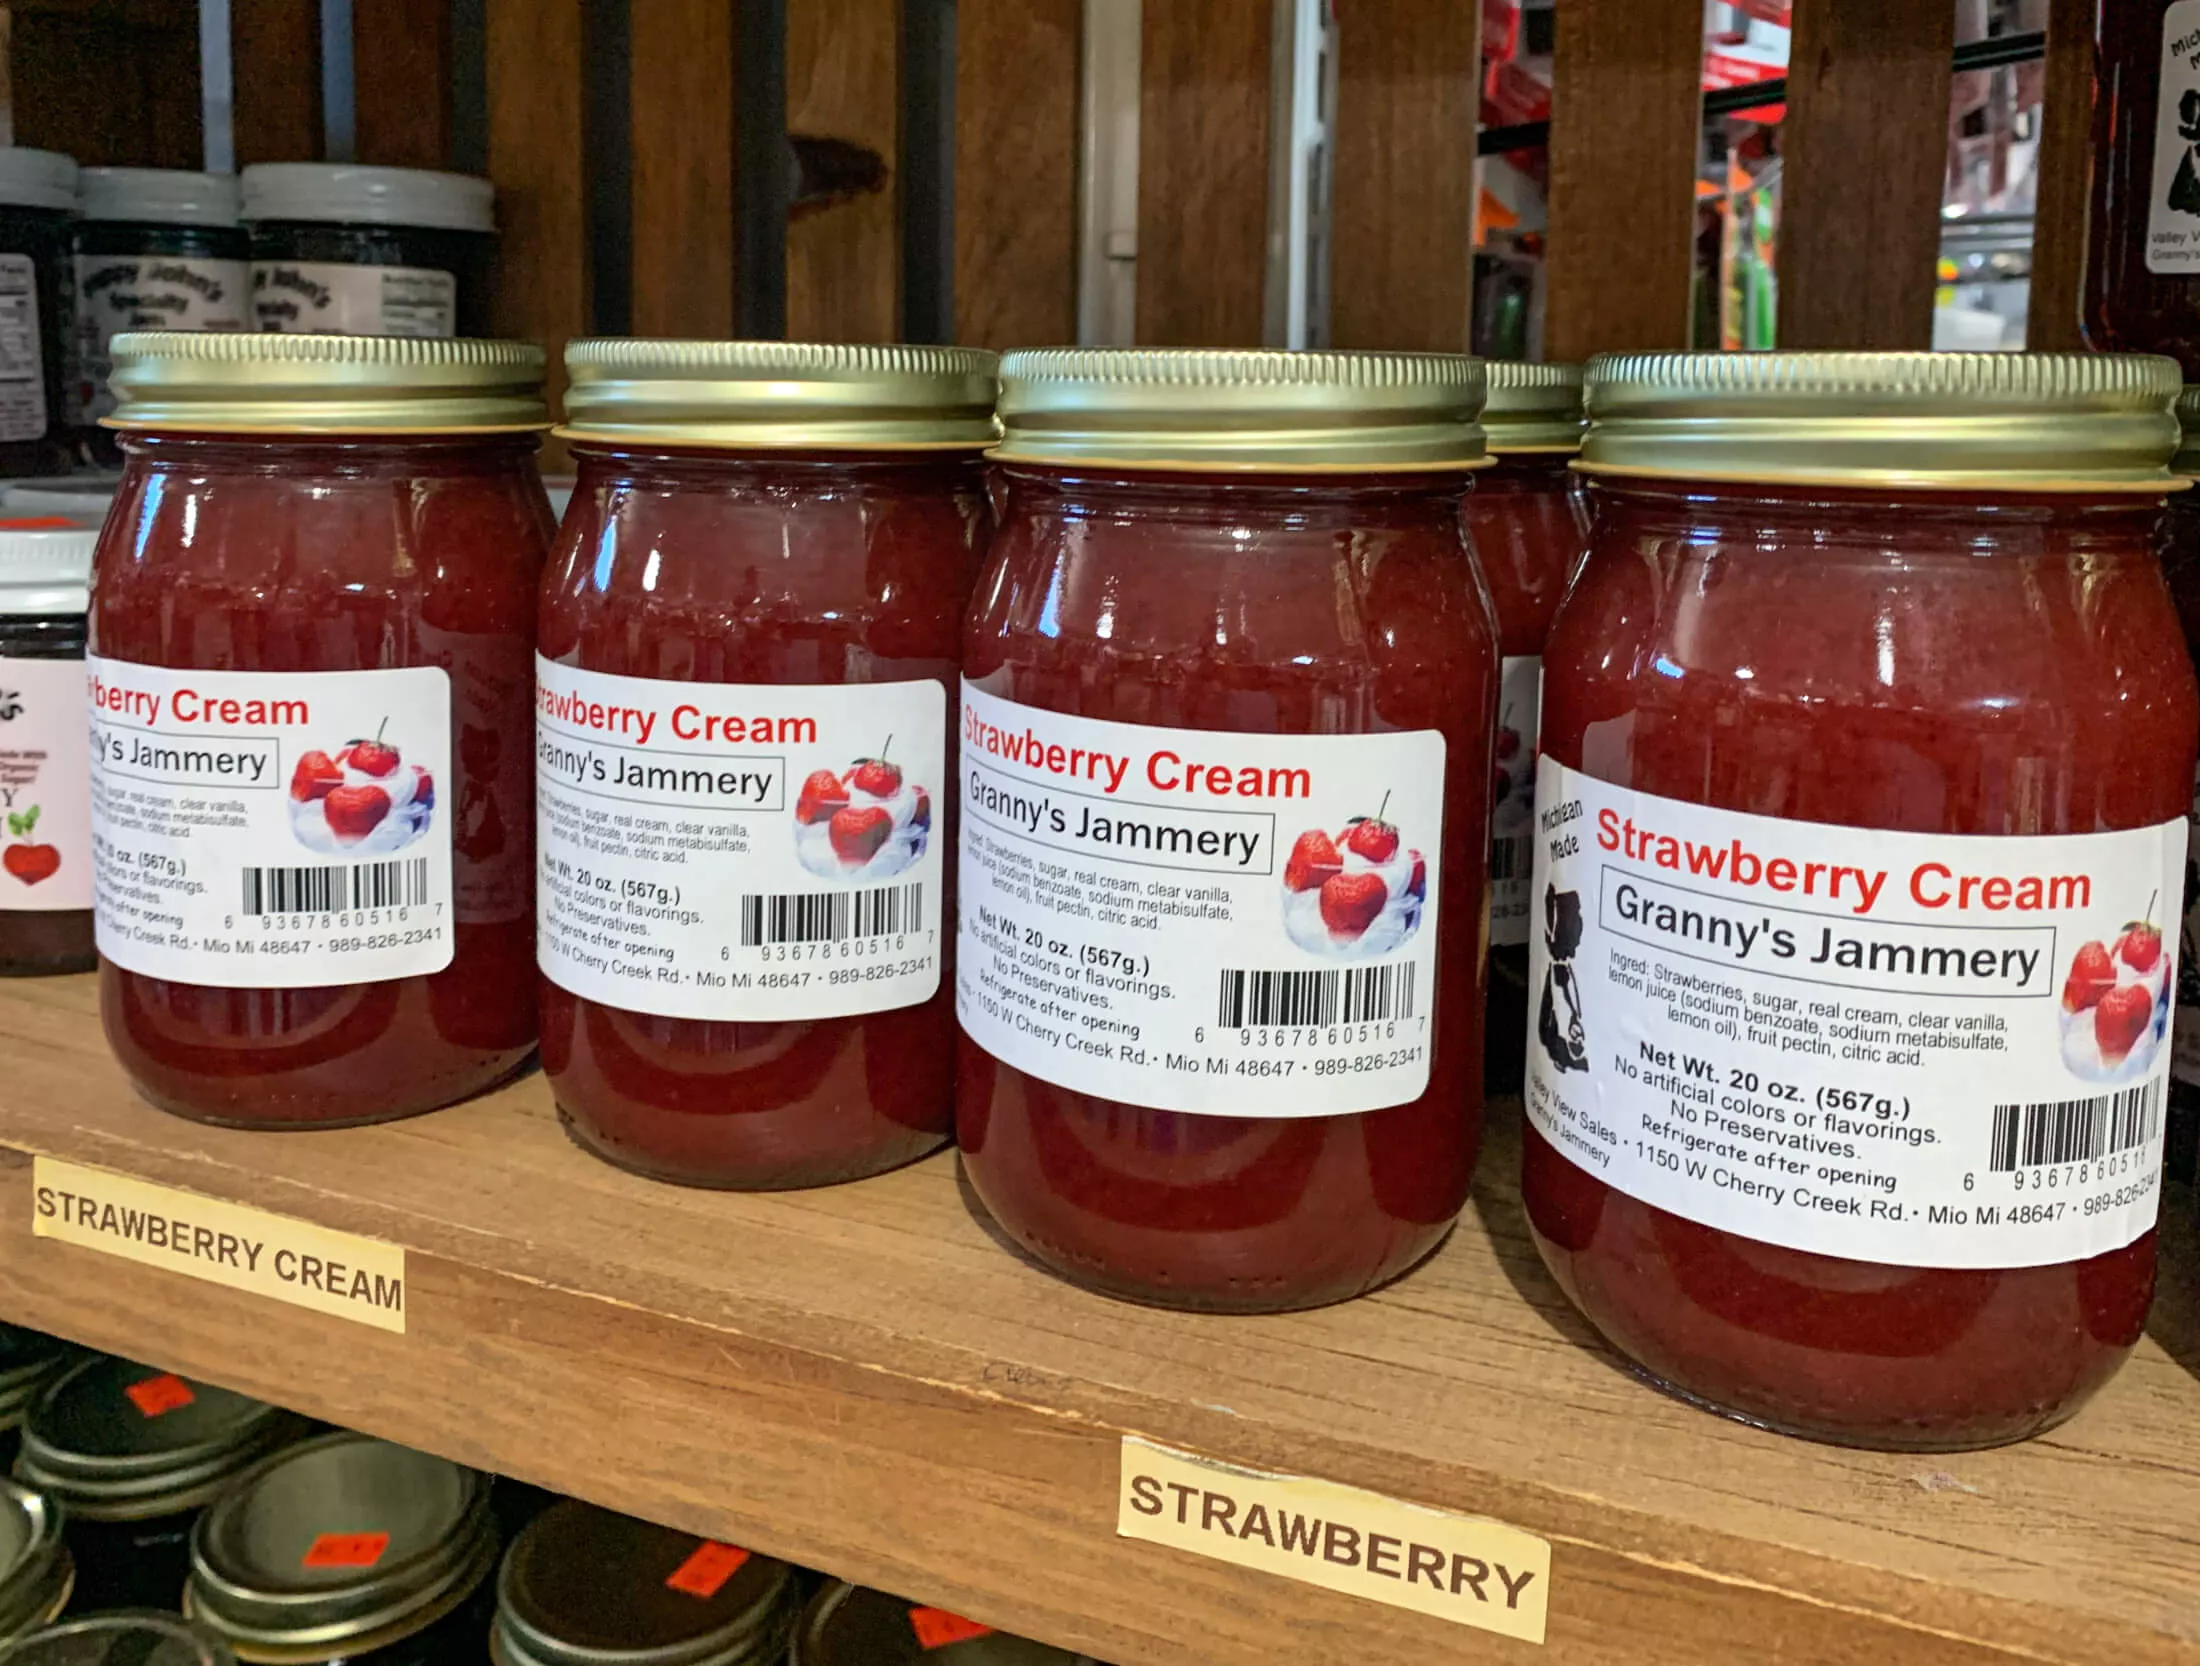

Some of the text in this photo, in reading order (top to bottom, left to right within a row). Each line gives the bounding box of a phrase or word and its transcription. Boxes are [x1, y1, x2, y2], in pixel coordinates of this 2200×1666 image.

[171, 688, 309, 725] Cream
[671, 704, 816, 743] Cream
[130, 737, 267, 781] Jammery
[965, 703, 1311, 798] Strawberry Cream
[613, 756, 773, 803] Jammery
[675, 820, 704, 835] clear
[708, 823, 750, 839] vanilla,
[970, 771, 1260, 865] Granny's Jammery
[138, 851, 187, 877] (567g.)
[626, 831, 751, 854] sodium metabisulfate,
[1550, 834, 1580, 863] Made
[1597, 808, 2091, 914] Strawberry Cream
[577, 868, 591, 887] 20
[595, 877, 616, 894] oz.
[621, 879, 680, 906] (567g.)
[1033, 873, 1084, 901] benzoate,
[1088, 890, 1134, 910] sodium
[1138, 900, 1233, 922] metabisulfate,
[1038, 861, 1070, 881] sugar,
[1074, 870, 1096, 886] real
[1100, 875, 1143, 895] cream,
[1147, 881, 1180, 898] clear
[1185, 887, 1233, 905] vanilla,
[609, 900, 623, 913] or
[627, 900, 704, 926] flavorings.
[1057, 899, 1094, 921] pectin,
[1098, 907, 1127, 926] citric
[1130, 915, 1161, 931] acid.
[1616, 883, 2040, 987] Granny's Jammery
[203, 938, 230, 953] Mio
[236, 939, 253, 954] Mi
[259, 939, 311, 954] 48647
[329, 927, 442, 952] 989-826-2341
[624, 942, 674, 963] opening
[720, 945, 730, 961] 6
[927, 929, 935, 944] 7
[979, 904, 1150, 978] Net Wt. 20 oz. (567g.)
[612, 959, 651, 980] Creek
[657, 967, 683, 984] Rd.
[697, 971, 726, 988] Mio
[731, 972, 751, 988] Mi
[757, 972, 811, 988] 48647
[829, 956, 932, 985] 989-826-2341
[993, 954, 1008, 976] No
[1011, 963, 1113, 1010] Preservatives.
[1020, 949, 1061, 977] colors
[1065, 966, 1080, 980] or
[1086, 967, 1176, 1001] flavorings.
[1610, 948, 2008, 1033] Ingred: Strawberries, sugar, real cream, clear vanilla,
[1040, 1001, 1077, 1022] after
[1081, 1013, 1140, 1042] opening
[1194, 1026, 1205, 1044] 6
[1417, 1016, 1426, 1033] 7
[1609, 966, 2008, 1052] lemon juice (sodium benzoate, sodium metabisulfate,
[1001, 1006, 1013, 1025] W
[1016, 1013, 1061, 1048] Cherry
[1066, 1032, 1113, 1058] Creek
[1120, 1046, 1150, 1066] Rd.
[1166, 1053, 1199, 1072] Mio
[1206, 1057, 1228, 1074] Mi
[1235, 1059, 1294, 1076] 48647
[1314, 1046, 1423, 1076] 989-826-2341
[1668, 1004, 1925, 1067] lemon oil), fruit pectin, citric acid.
[1615, 1054, 1941, 1147] No artificial colors or flavorings.
[1640, 1040, 1910, 1121] Net Wt. 20 oz. (567g.)
[1560, 1126, 1611, 1169] Jammery
[1671, 1099, 1862, 1160] No Preservatives.
[1552, 1089, 1577, 1121] View
[1580, 1111, 1617, 1145] Sales
[1636, 1141, 1679, 1171] 1150
[1685, 1158, 1707, 1180] W
[1713, 1168, 1785, 1205] Cherry
[1793, 1188, 1862, 1216] Creek
[1870, 1200, 1909, 1221] Rd.
[1928, 1205, 1967, 1225] Mio
[1975, 1206, 2000, 1225] Mi
[2006, 1202, 2066, 1224] 48647
[1642, 1113, 1897, 1194] Refrigerate after opening
[1963, 1172, 1975, 1191] 6
[37, 1187, 402, 1312] STRAWBERRY CREAM
[1129, 1474, 1536, 1610] STRAWBERRY
